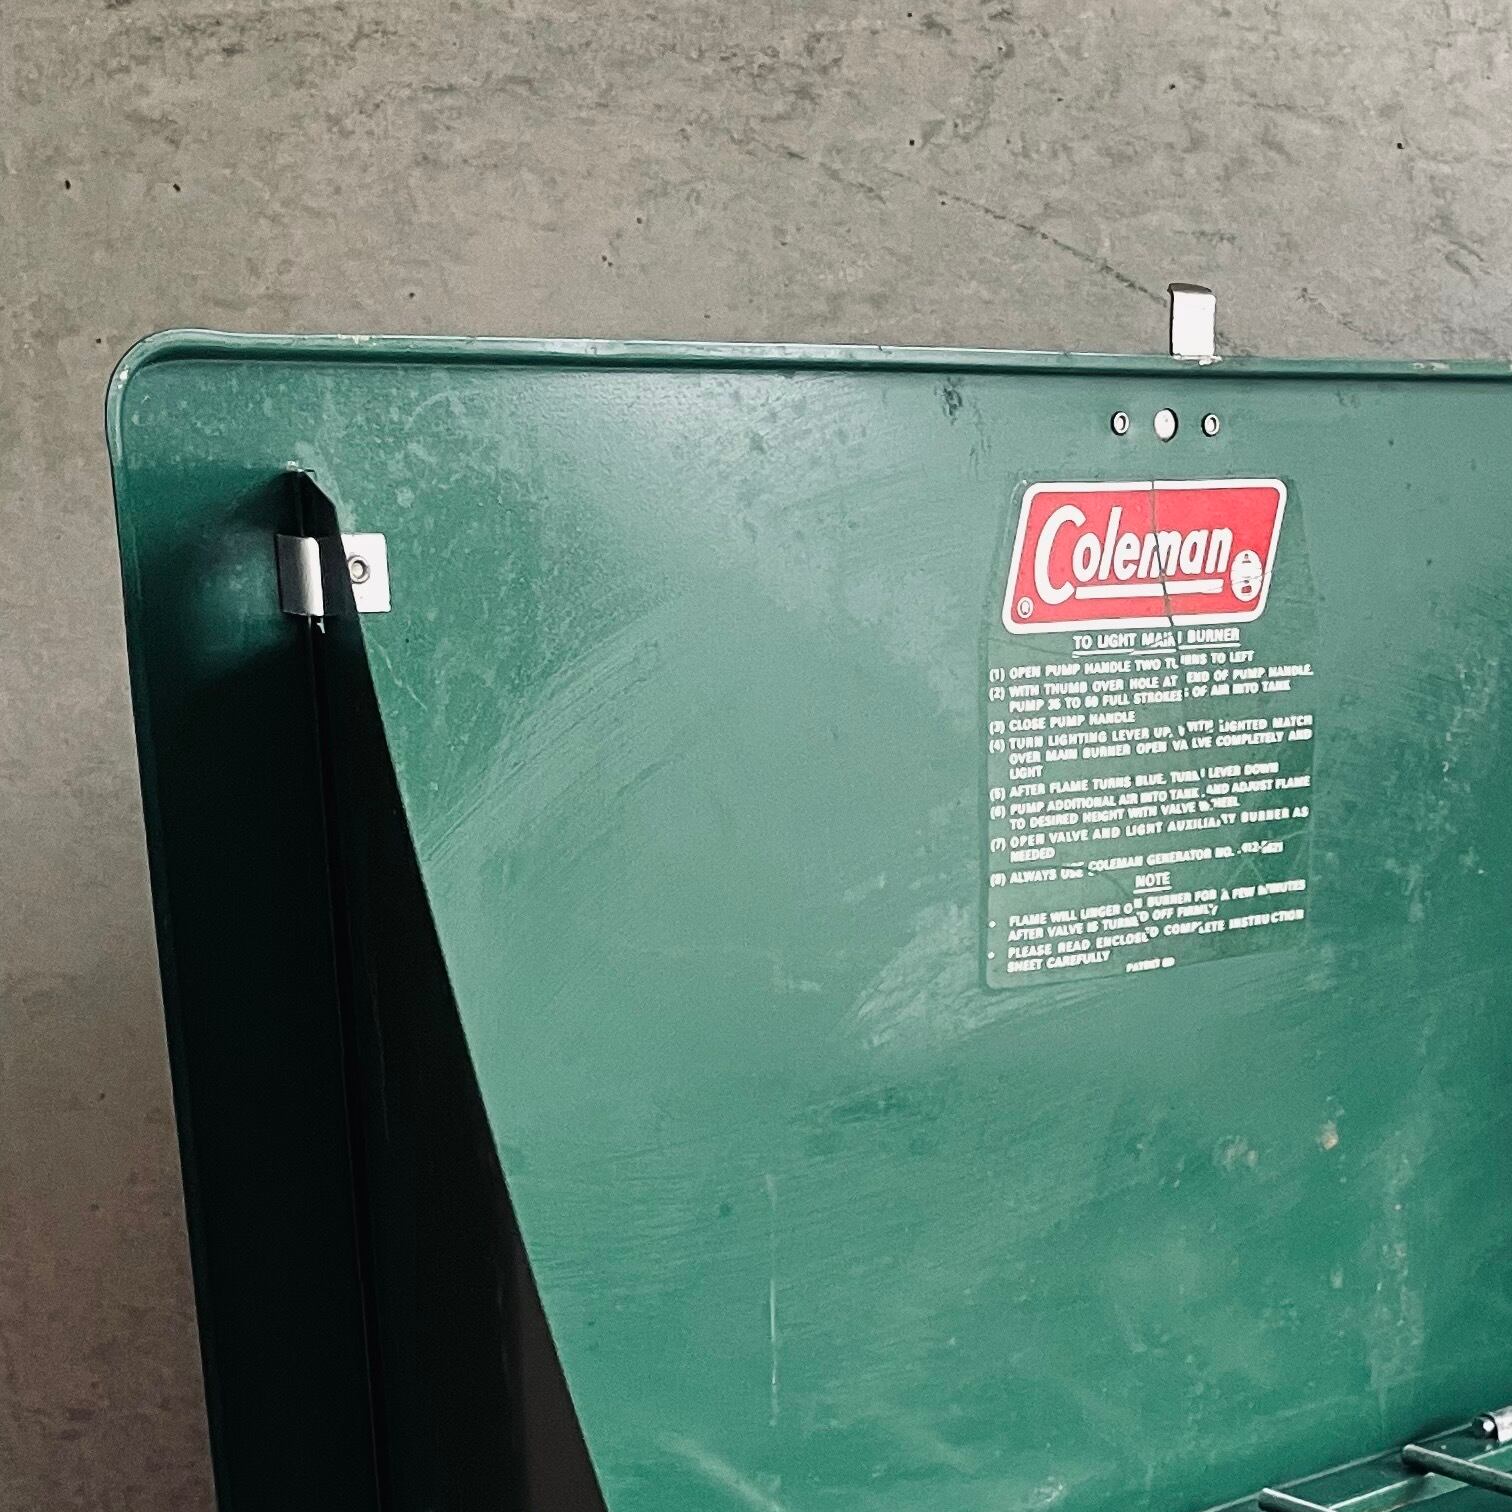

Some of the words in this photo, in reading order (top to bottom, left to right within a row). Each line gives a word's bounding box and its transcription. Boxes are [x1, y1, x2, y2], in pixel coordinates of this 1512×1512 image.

[1034, 504, 1233, 605] Coleman
[1072, 635, 1093, 650] TO
[1097, 632, 1137, 649] LIGHT
[1187, 627, 1240, 647] BURNER
[989, 667, 1006, 683] (1)
[1008, 665, 1042, 680] OPEN
[1045, 663, 1081, 677] PUMP
[1084, 660, 1132, 675] HANDLE
[1134, 658, 1161, 671] TWO
[1210, 652, 1227, 664] TO
[1229, 650, 1254, 663] LEFT
[989, 686, 1006, 701] (2)
[1008, 684, 1040, 698] WITH
[1043, 681, 1088, 695] THUMB
[1091, 678, 1124, 693] OVER
[1129, 676, 1160, 690] HOLE
[1162, 674, 1178, 688] AT
[1185, 671, 1211, 683] END
[1213, 669, 1229, 682] OF
[1232, 667, 1266, 680] PUMP
[1008, 698, 1044, 713] PUMP
[1064, 696, 1082, 709] TO
[1102, 694, 1130, 707] FULL
[1192, 685, 1209, 698] OF
[1210, 683, 1230, 696] AIR
[1232, 681, 1260, 694] INTO
[1261, 679, 1291, 692] TANK
[989, 739, 1006, 754] (4)
[1008, 735, 1044, 750] TURN
[1047, 731, 1108, 747] LIGHTING
[1111, 727, 1150, 742] LEVER
[1271, 715, 1314, 729] MATCH
[1008, 717, 1047, 732] CLOSE
[1049, 714, 1086, 728] PUMP
[1088, 710, 1136, 725] HANDLE
[1008, 750, 1042, 765] OVER
[1045, 748, 1078, 762] MAIN
[1082, 743, 1131, 759] BURNER
[1135, 740, 1168, 755] OPEN
[1214, 731, 1285, 747] COMPLETELY
[1287, 728, 1314, 741] AND
[1008, 765, 1044, 780] LIGHT
[1009, 783, 1046, 797] AFTER
[1049, 779, 1089, 794] FLAME
[1092, 776, 1132, 790] TURNS
[1207, 764, 1241, 779] LEVER
[1243, 762, 1279, 776] DOWN
[1009, 801, 1045, 816] PUMP
[1046, 795, 1117, 811] ADDITIONAL
[1118, 792, 1139, 806] AIR
[1139, 790, 1168, 804] INTO
[1205, 783, 1230, 795] AND
[1231, 779, 1273, 793] ADJUST
[1274, 775, 1311, 789] FLAME
[1009, 817, 1026, 830] TO
[1029, 812, 1079, 829] DESIRED
[1082, 808, 1125, 823] HEIGHT
[1127, 805, 1158, 819] WITH
[1160, 801, 1196, 815] VALVE
[1009, 833, 1045, 849] OPEN
[1048, 829, 1090, 844] VALVE
[1092, 826, 1121, 840] AND
[1124, 821, 1164, 837] LIGHT
[1240, 808, 1289, 823] BURNER
[1291, 806, 1310, 818] AS
[1009, 847, 1056, 863] NEEDED
[1009, 868, 1057, 884] ALWAYS
[1086, 855, 1144, 871] COLEMAN
[1146, 848, 1213, 866] GENERATOR
[1134, 871, 1171, 888] NOTE
[1008, 912, 1048, 927] FLAME
[1049, 910, 1078, 923] WILL
[1079, 904, 1121, 920] LINGER
[1146, 892, 1193, 908] BURNER
[1194, 889, 1218, 902] FOR
[1220, 889, 1231, 901] A
[1231, 886, 1256, 899] FEW
[1007, 927, 1044, 941] AFTER
[1046, 922, 1084, 938] VALVE
[1086, 920, 1099, 933] IS
[1151, 907, 1175, 921] OFF
[1007, 943, 1053, 959] PLEASE
[1057, 939, 1091, 954] READ
[1228, 909, 1305, 929] INSTRUCTION
[1006, 958, 1044, 973] SHEET
[1046, 950, 1111, 969] CAREFULLY
